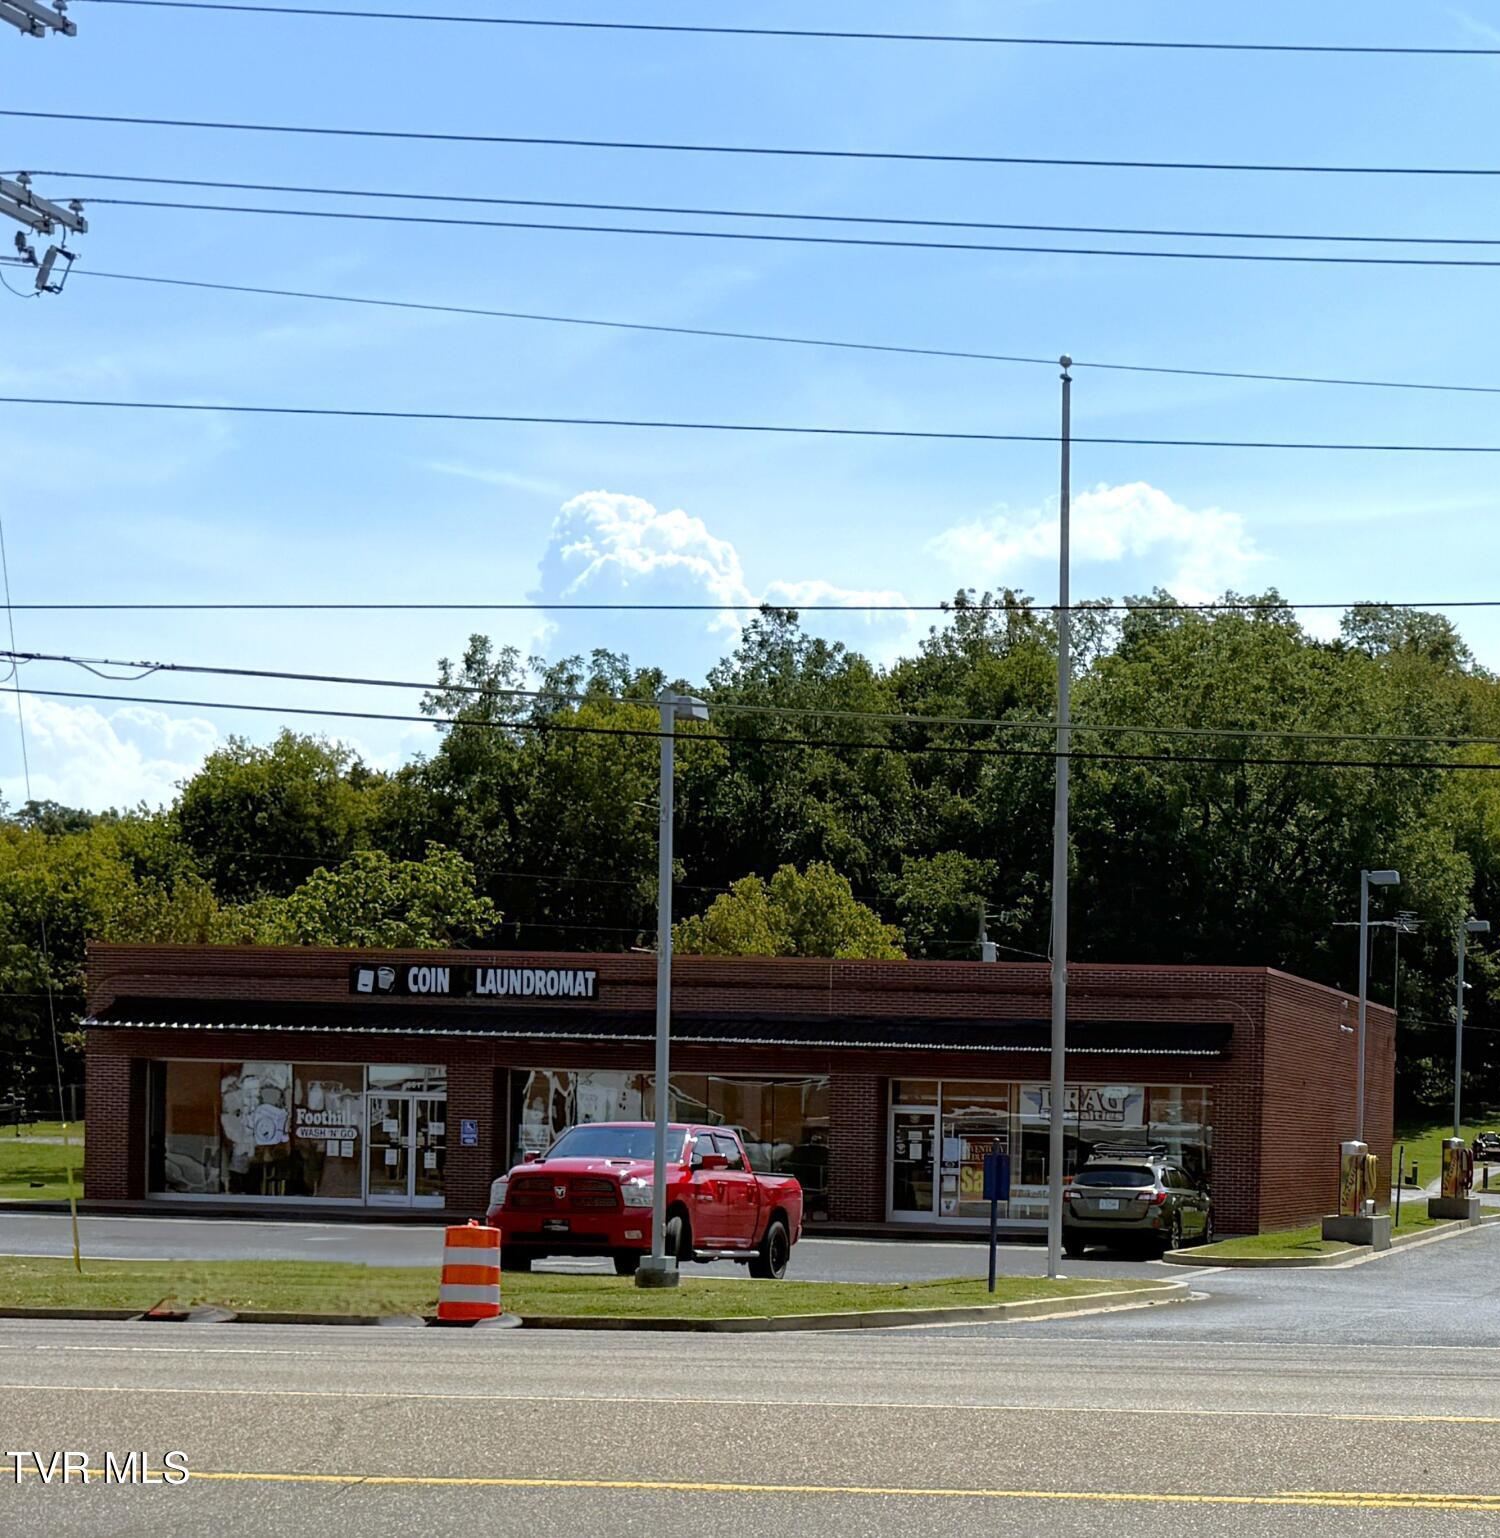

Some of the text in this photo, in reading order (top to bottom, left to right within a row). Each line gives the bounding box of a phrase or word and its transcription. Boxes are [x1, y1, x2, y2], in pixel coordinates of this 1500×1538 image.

[407, 966, 597, 997] COIN LAUNDROMAT
[300, 1128, 326, 1138] WASH
[341, 1129, 354, 1138] GO
